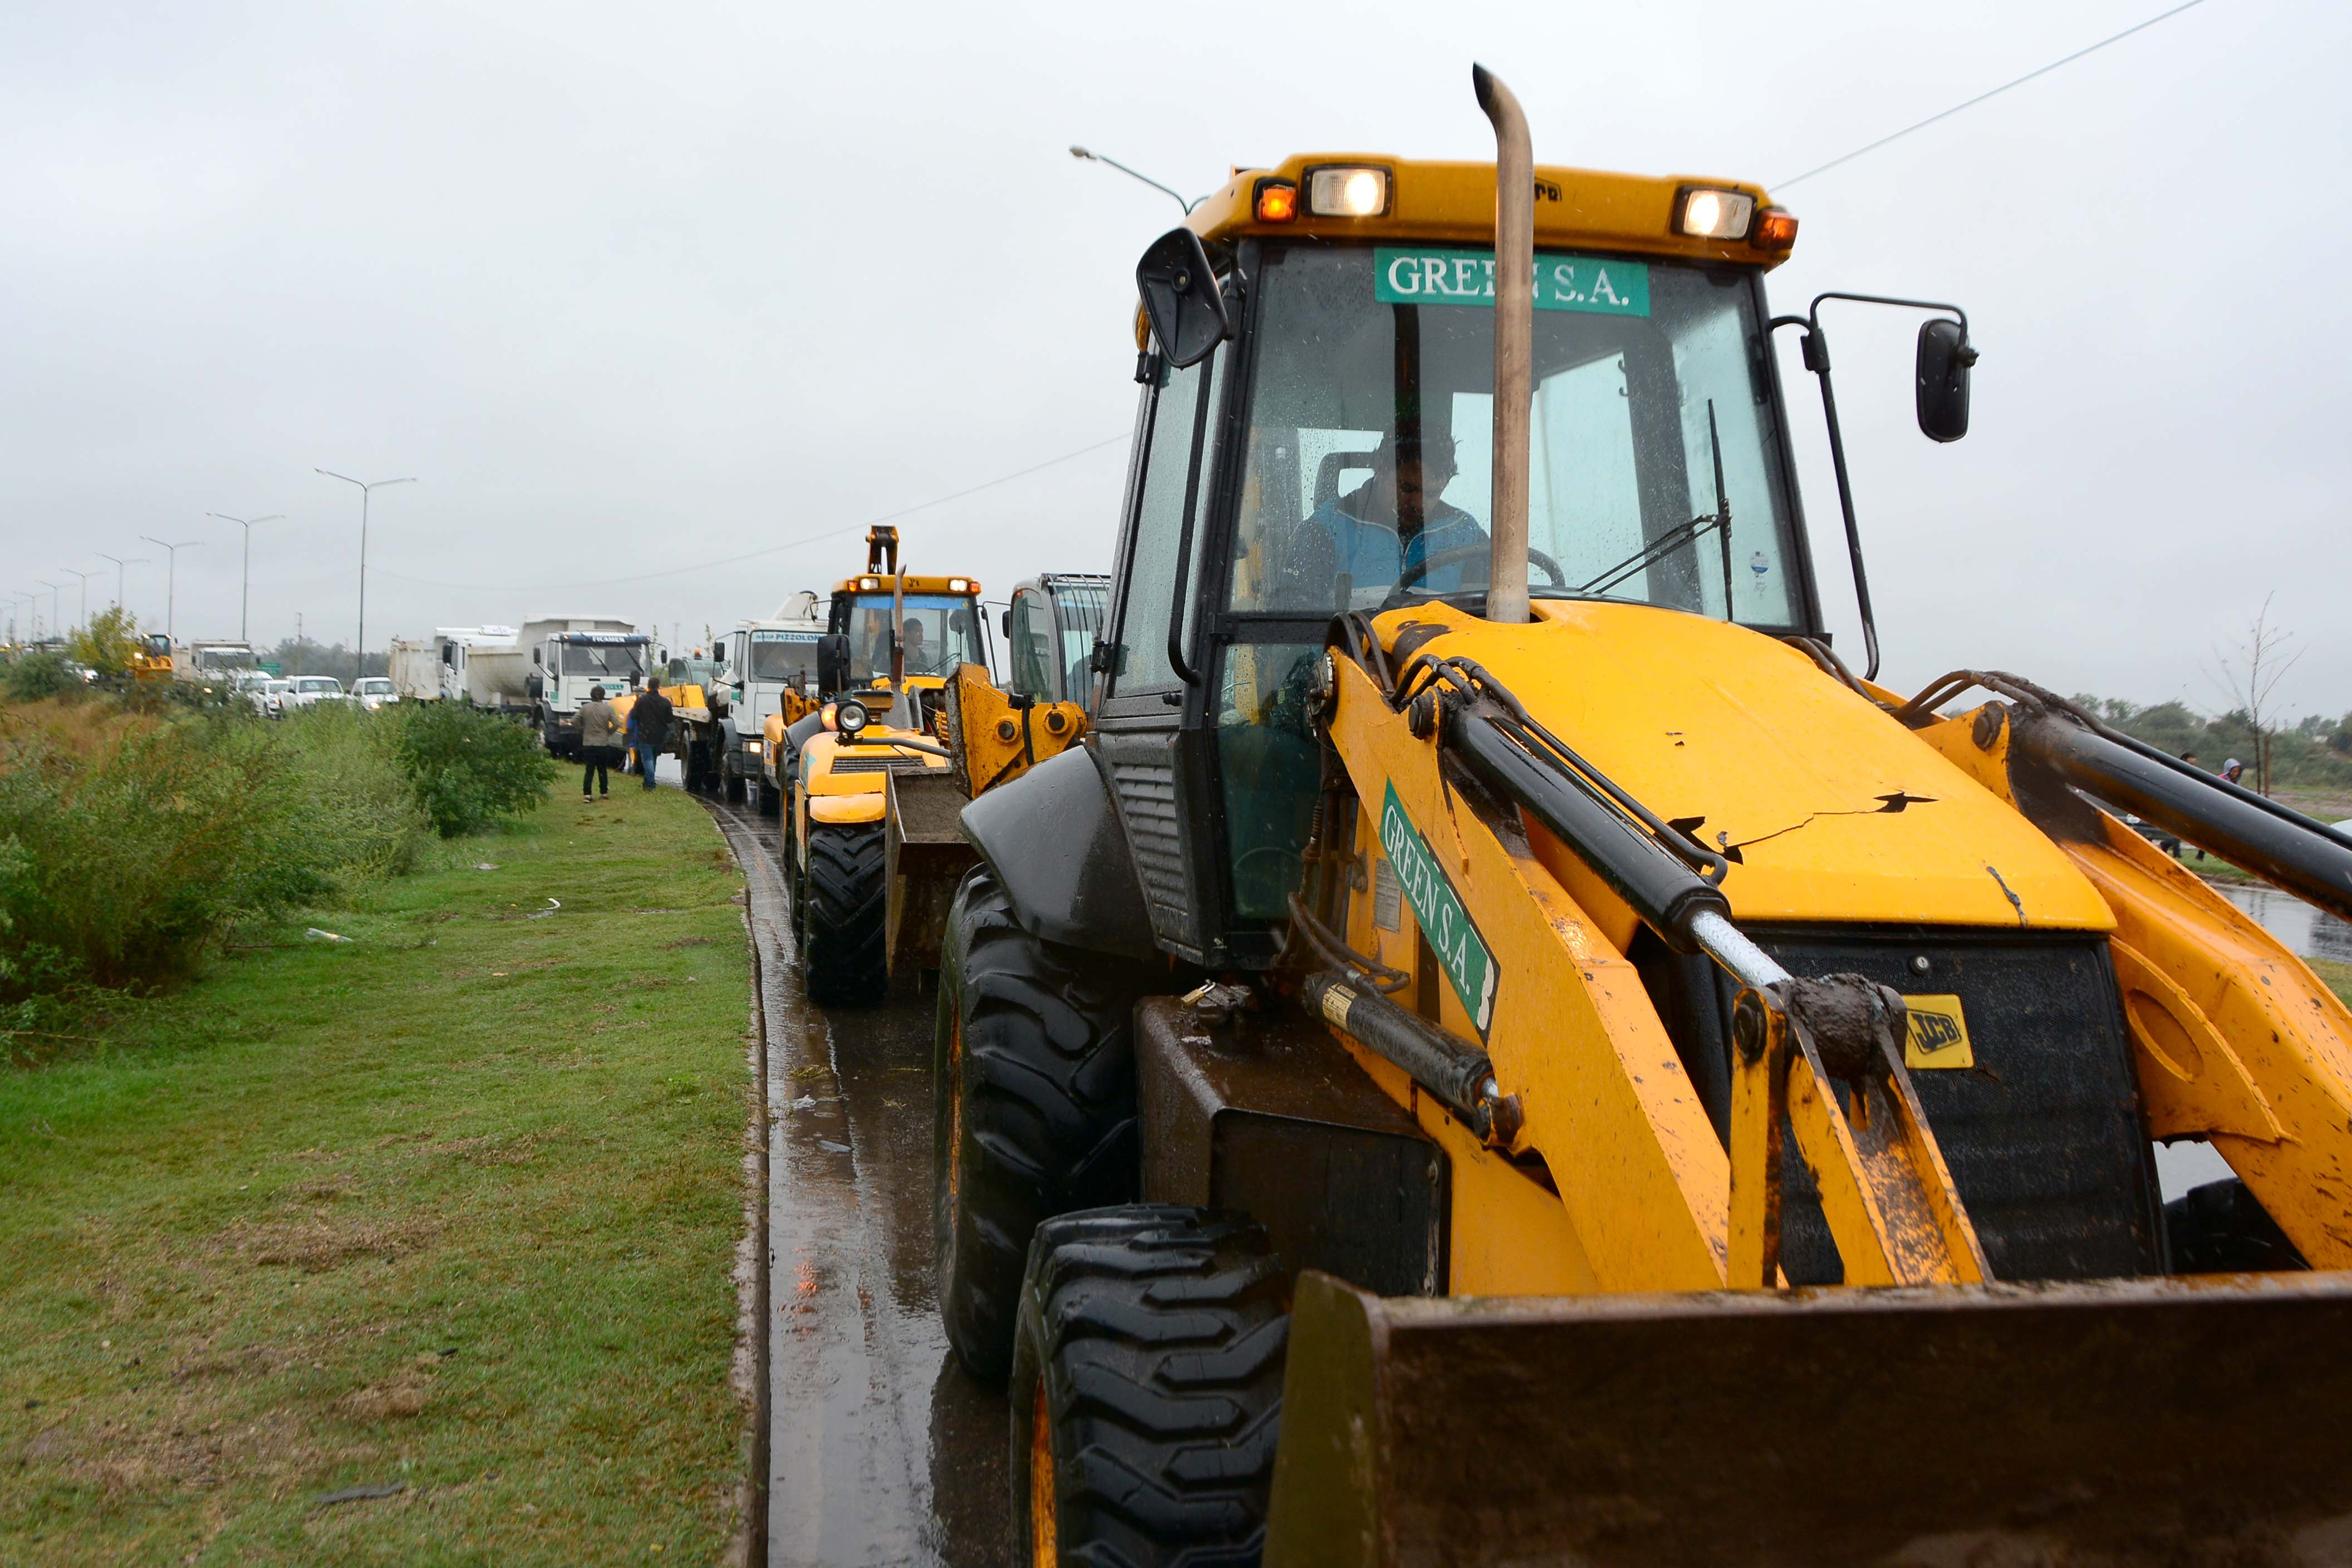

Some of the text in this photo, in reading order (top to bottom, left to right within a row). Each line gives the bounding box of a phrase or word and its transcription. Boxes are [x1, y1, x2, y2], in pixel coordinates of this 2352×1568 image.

[1554, 264, 1630, 307] S.A.
[1384, 805, 1440, 928] GREEN
[1438, 903, 1470, 995] S.A.
[1911, 1013, 1958, 1051] JCB
